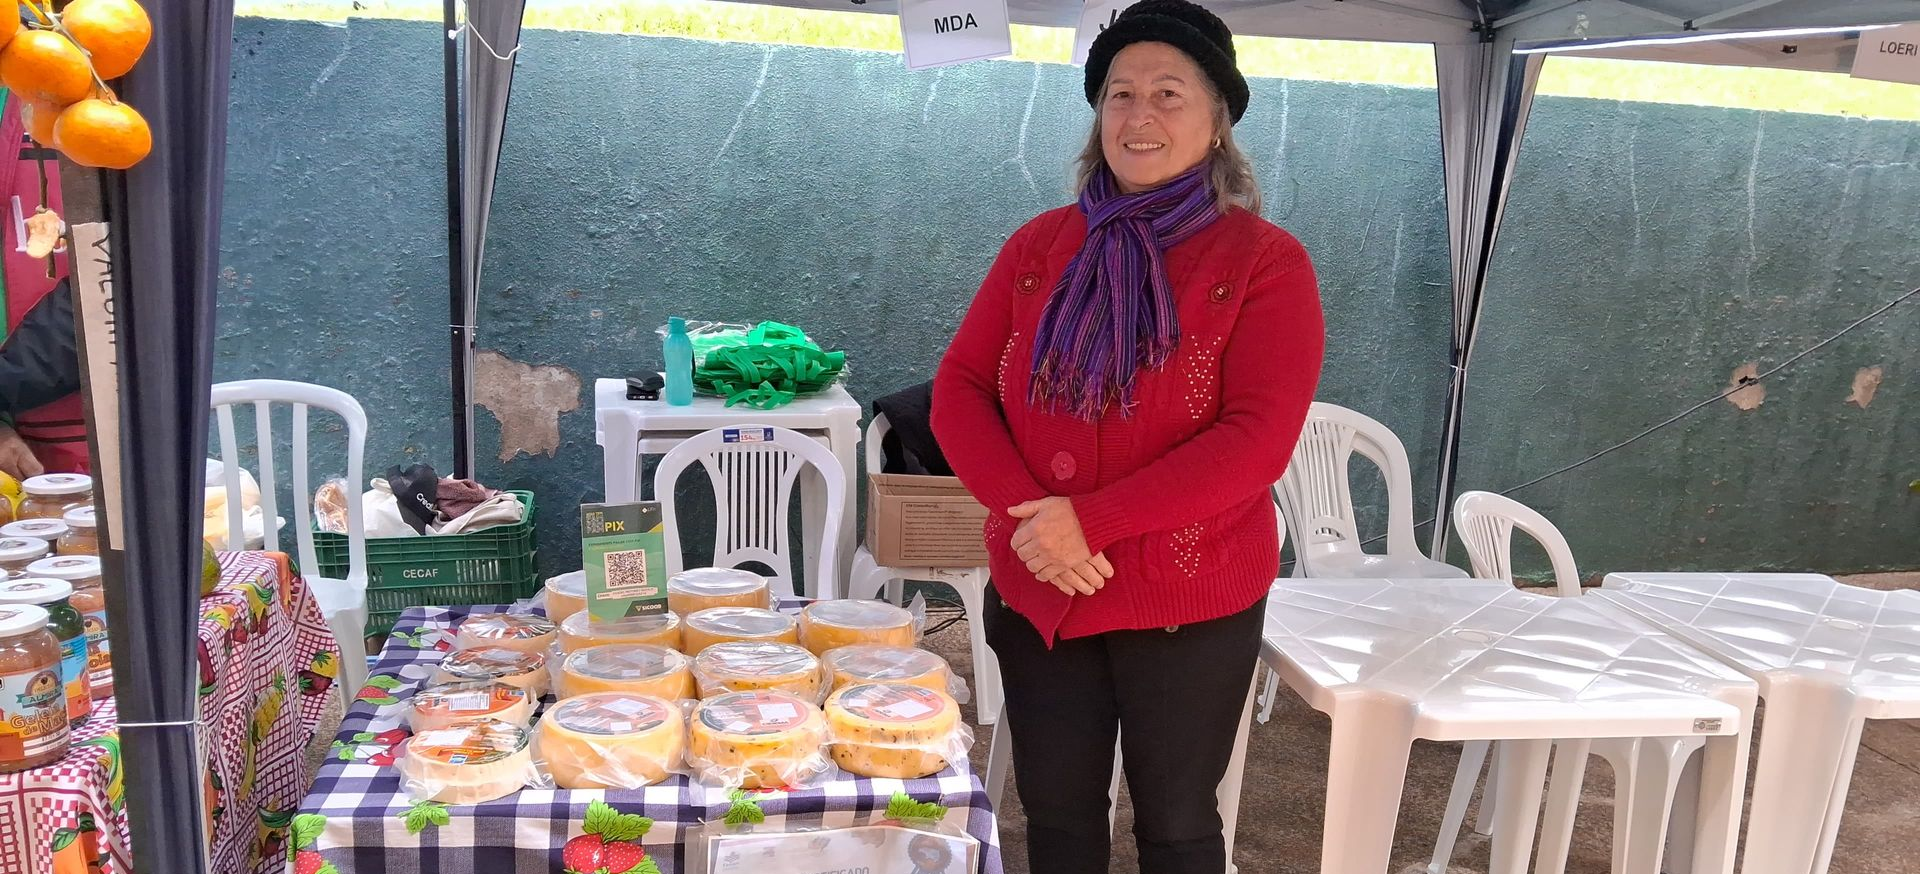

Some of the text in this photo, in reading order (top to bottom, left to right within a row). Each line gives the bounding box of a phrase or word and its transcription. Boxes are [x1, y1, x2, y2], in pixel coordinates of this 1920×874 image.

[934, 13, 978, 34] MDA
[1879, 41, 1918, 56] LOERI
[604, 520, 625, 532] PIX
[402, 568, 439, 579] CECAF
